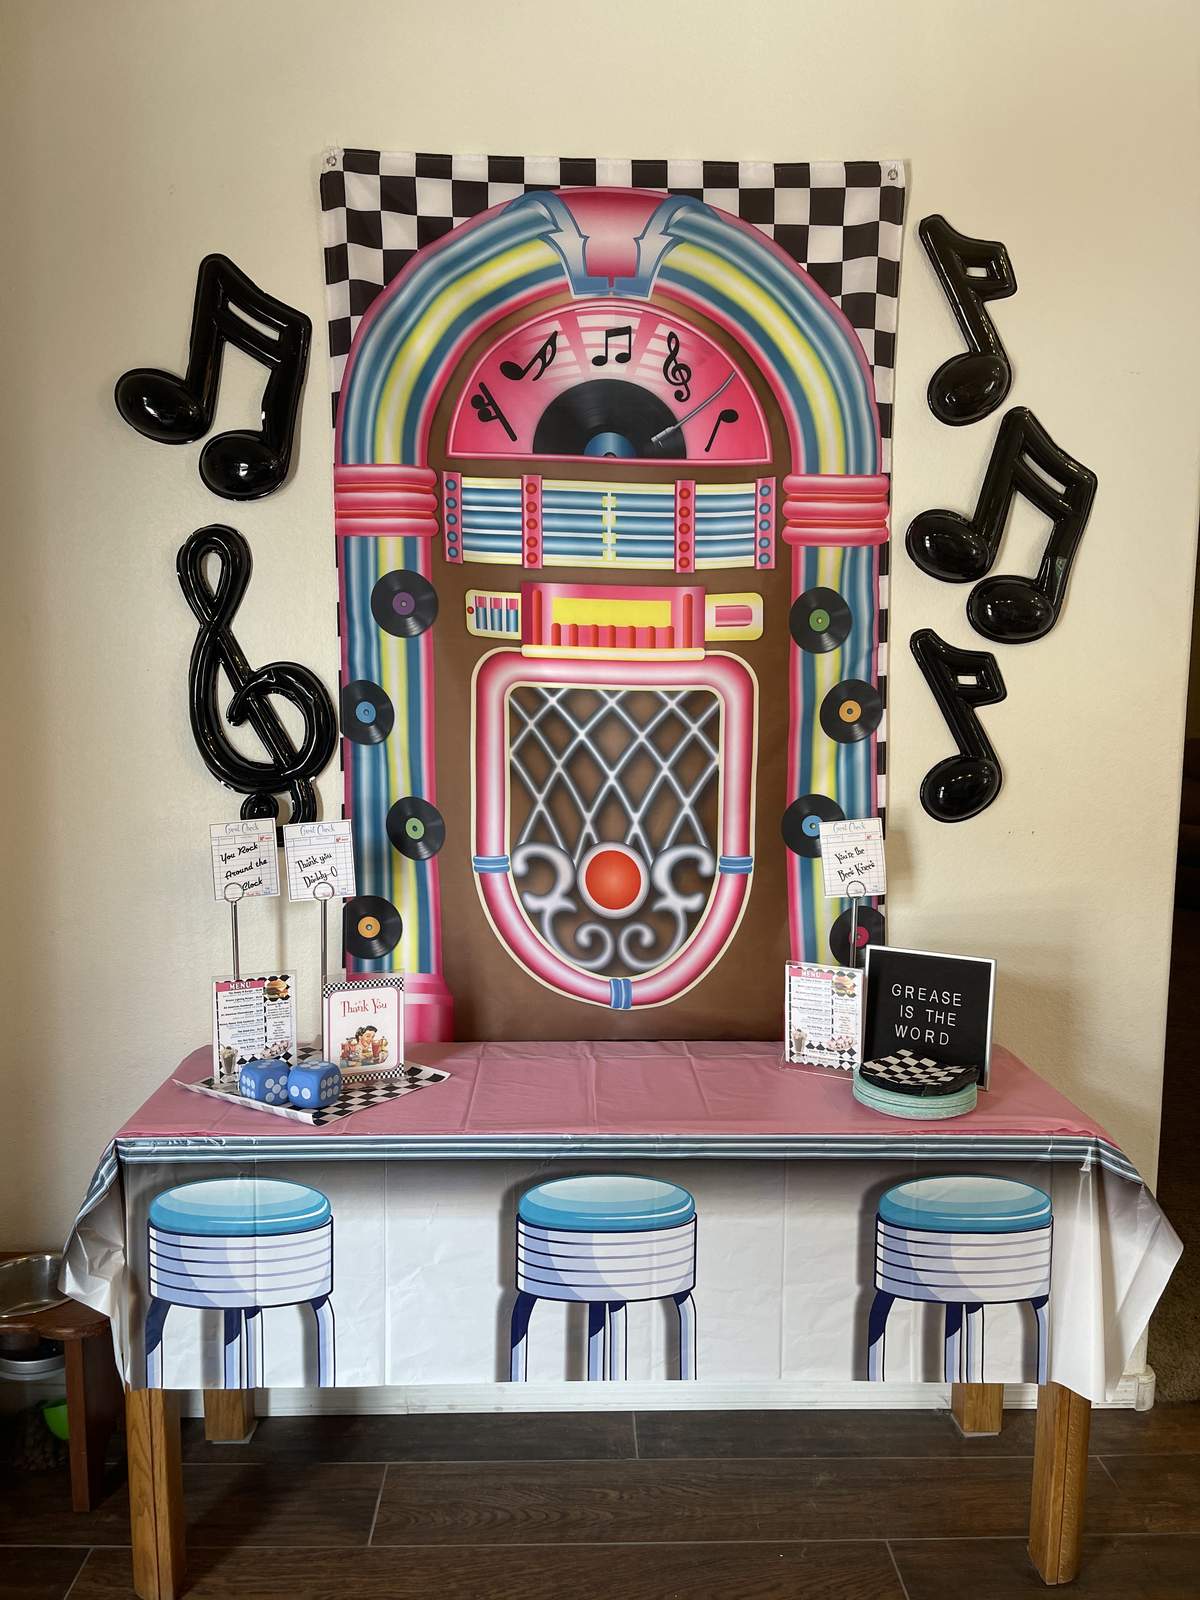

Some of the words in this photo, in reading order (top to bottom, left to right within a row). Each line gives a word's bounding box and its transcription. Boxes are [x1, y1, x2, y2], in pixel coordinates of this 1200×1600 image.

[220, 852, 235, 864] You
[238, 842, 258, 857] Rock
[854, 846, 865, 856] the
[224, 863, 253, 880] Around
[255, 857, 268, 868] the
[295, 856, 319, 872] Thank
[320, 852, 332, 864] you
[241, 877, 263, 891] Clock
[801, 969, 820, 979] MENU
[229, 982, 251, 990] MENU
[891, 983, 962, 1007] GREASE
[340, 999, 369, 1017] Thank
[371, 998, 388, 1014] You
[900, 1004, 914, 1019] IS
[925, 1009, 957, 1027] THE
[894, 1023, 949, 1046] WORD
